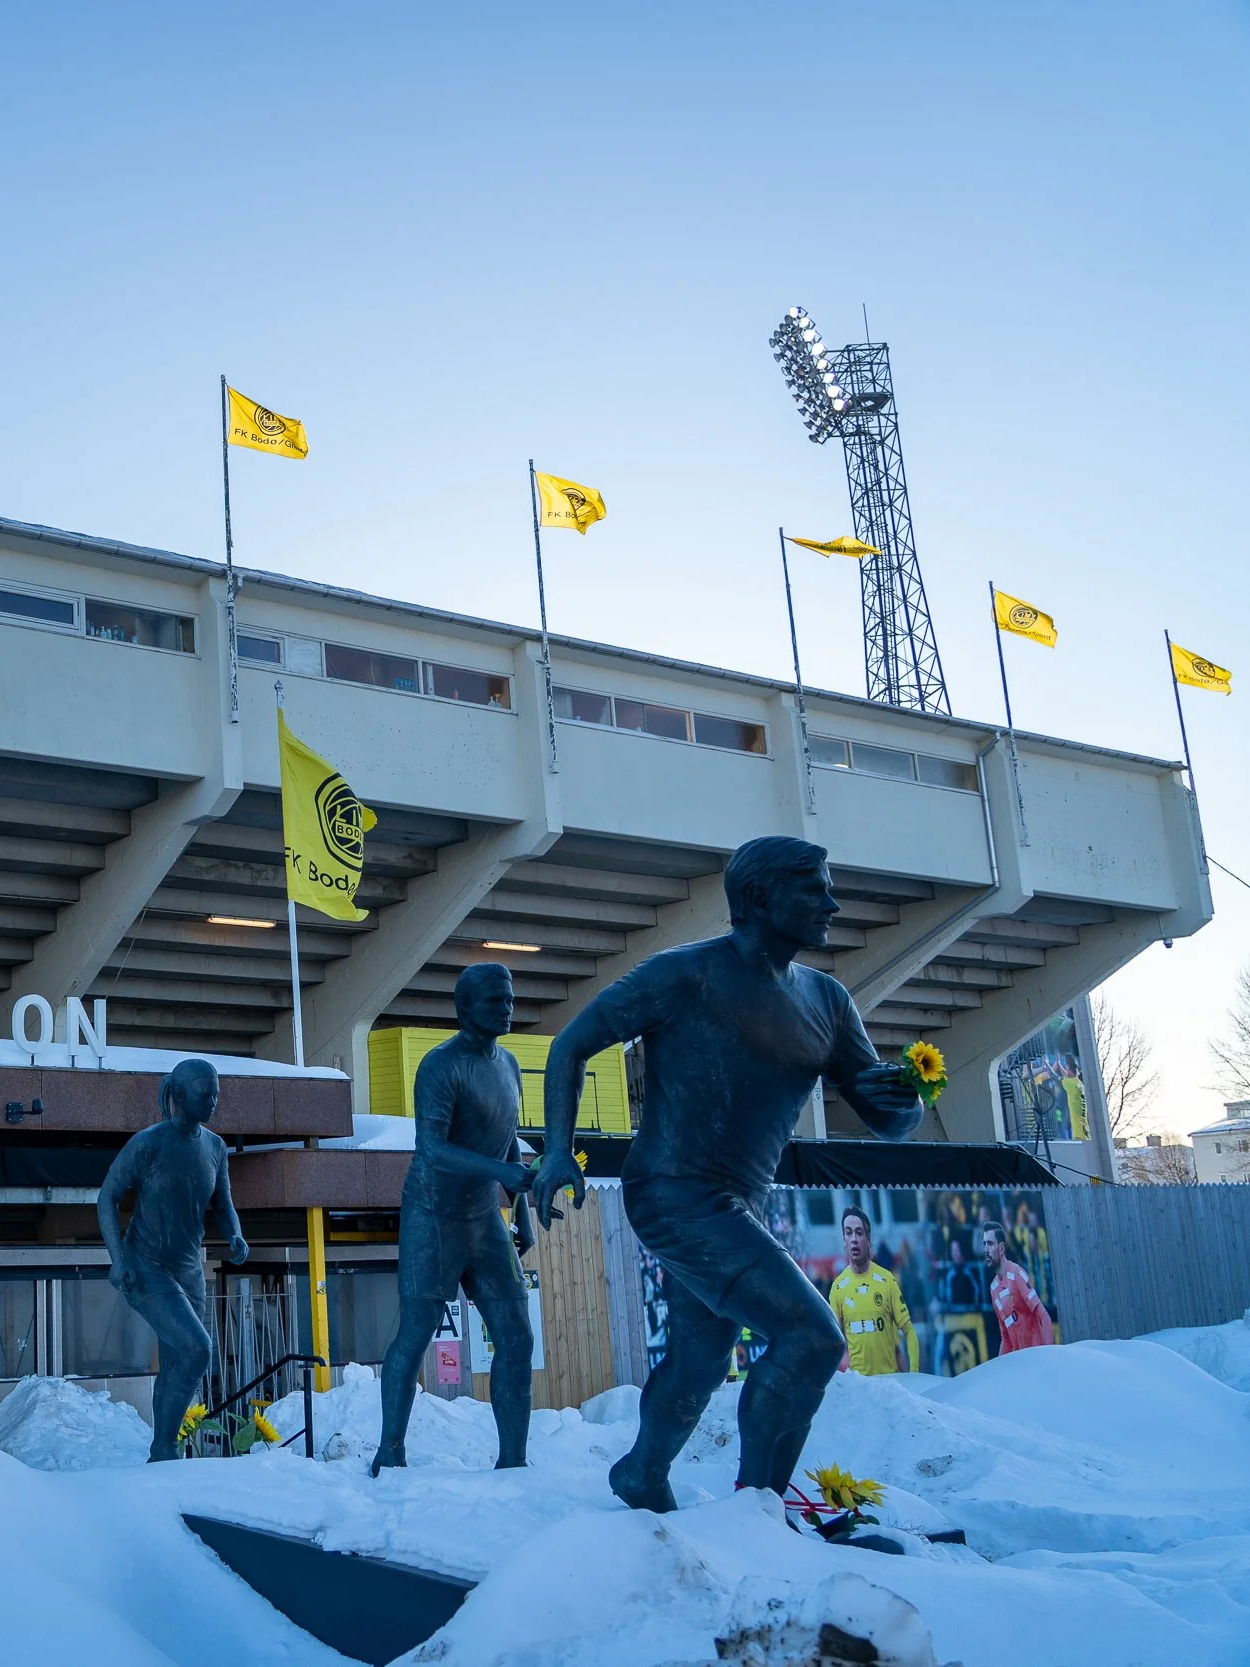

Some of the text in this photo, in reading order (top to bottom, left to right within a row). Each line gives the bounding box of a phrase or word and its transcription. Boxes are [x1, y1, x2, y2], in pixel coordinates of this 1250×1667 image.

[234, 428, 248, 439] FK
[337, 825, 362, 840] BOD
[435, 1303, 459, 1339] A
